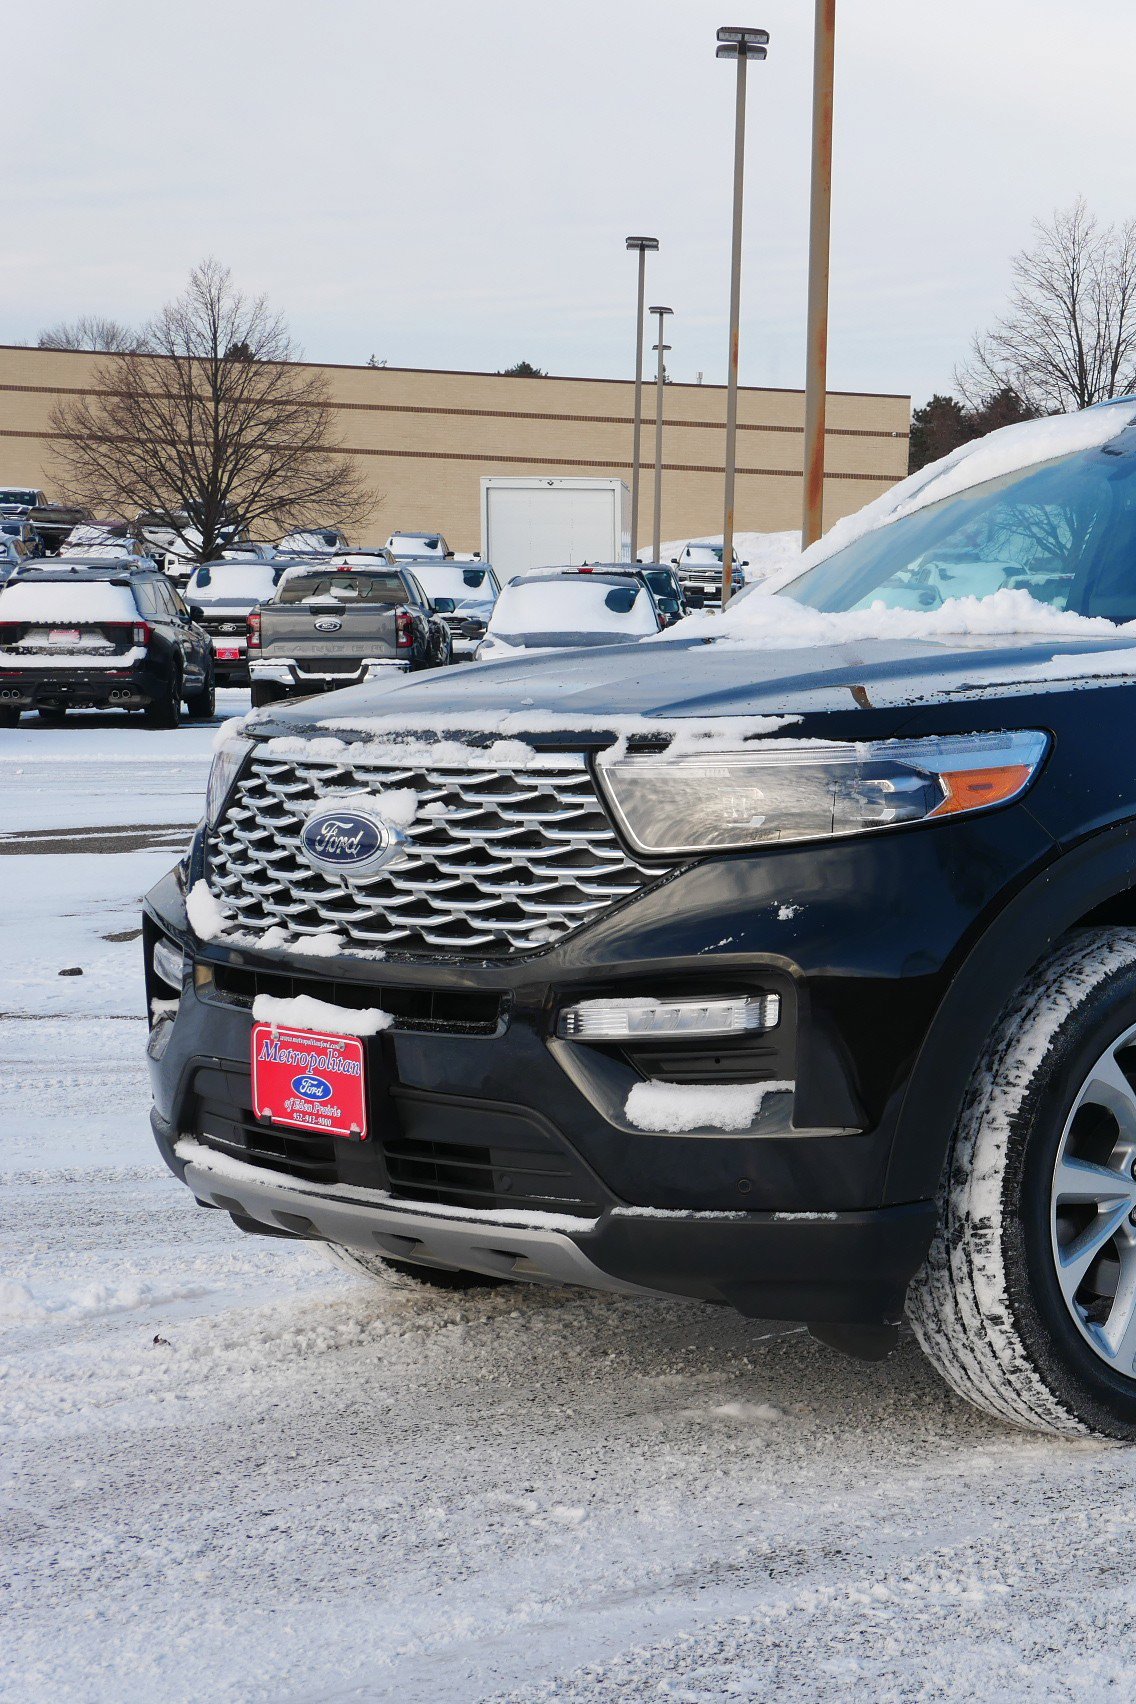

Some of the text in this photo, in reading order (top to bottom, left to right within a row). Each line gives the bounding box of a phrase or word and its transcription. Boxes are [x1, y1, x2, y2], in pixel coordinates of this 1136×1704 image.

[315, 820, 364, 858] Ford
[259, 1039, 361, 1076] Metropolitan
[299, 1078, 324, 1097] Ford
[284, 1097, 294, 1113] of
[293, 1098, 313, 1113] Eden
